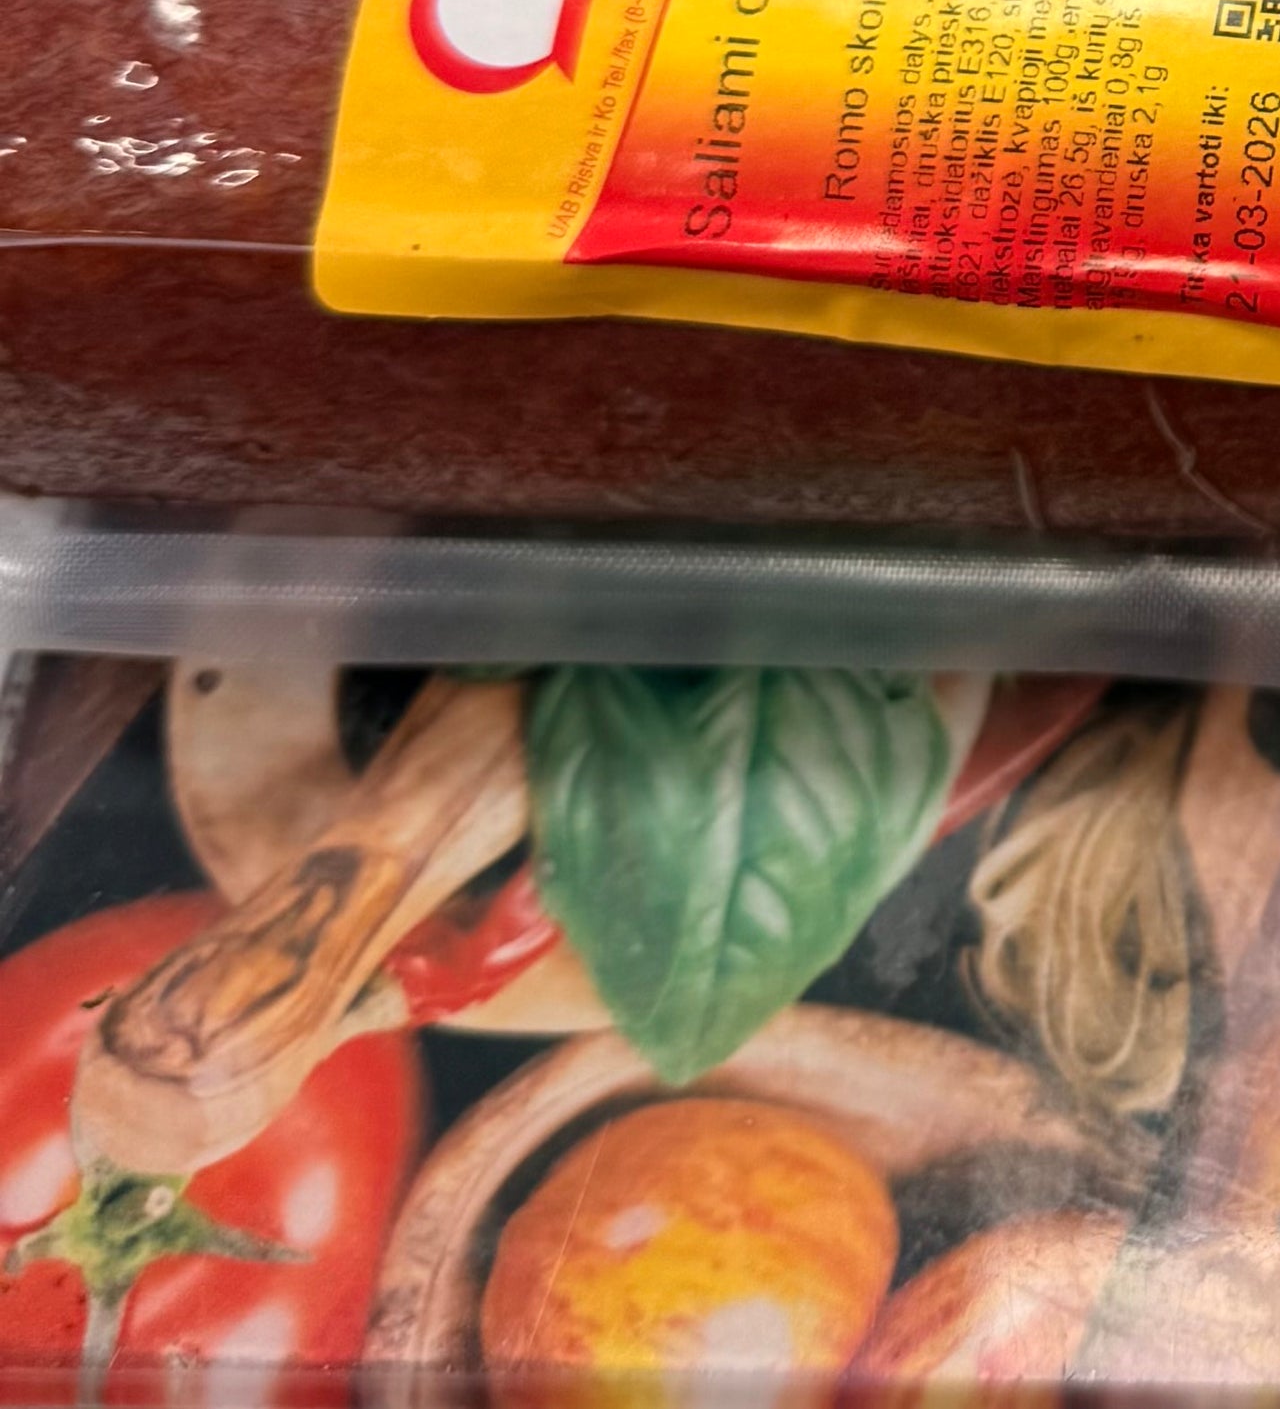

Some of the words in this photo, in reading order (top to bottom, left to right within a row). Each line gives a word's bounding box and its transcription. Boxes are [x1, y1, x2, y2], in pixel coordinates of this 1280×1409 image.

[899, 13, 932, 84] dalys
[1075, 14, 1117, 80] kurių
[1117, 8, 1143, 29] iš
[1002, 49, 1047, 154] kvapioji
[1072, 91, 1097, 112] iš
[1103, 37, 1143, 95] 0,8g
[1132, 66, 1169, 124] 2,1g
[1202, 85, 1230, 126] iki:
[546, 200, 583, 239] UAB
[567, 141, 603, 197] Ristva
[592, 96, 618, 121] Ko
[683, 34, 762, 239] Saliami
[822, 88, 870, 202] Romo
[912, 93, 947, 187] druska
[967, 114, 1002, 219] dažiklis
[1016, 120, 1062, 308] Maistingumas
[1042, 43, 1080, 105] 100g
[1120, 133, 1154, 228] druska
[1190, 133, 1223, 223] vartoti
[928, 85, 977, 298] antioksidatorius
